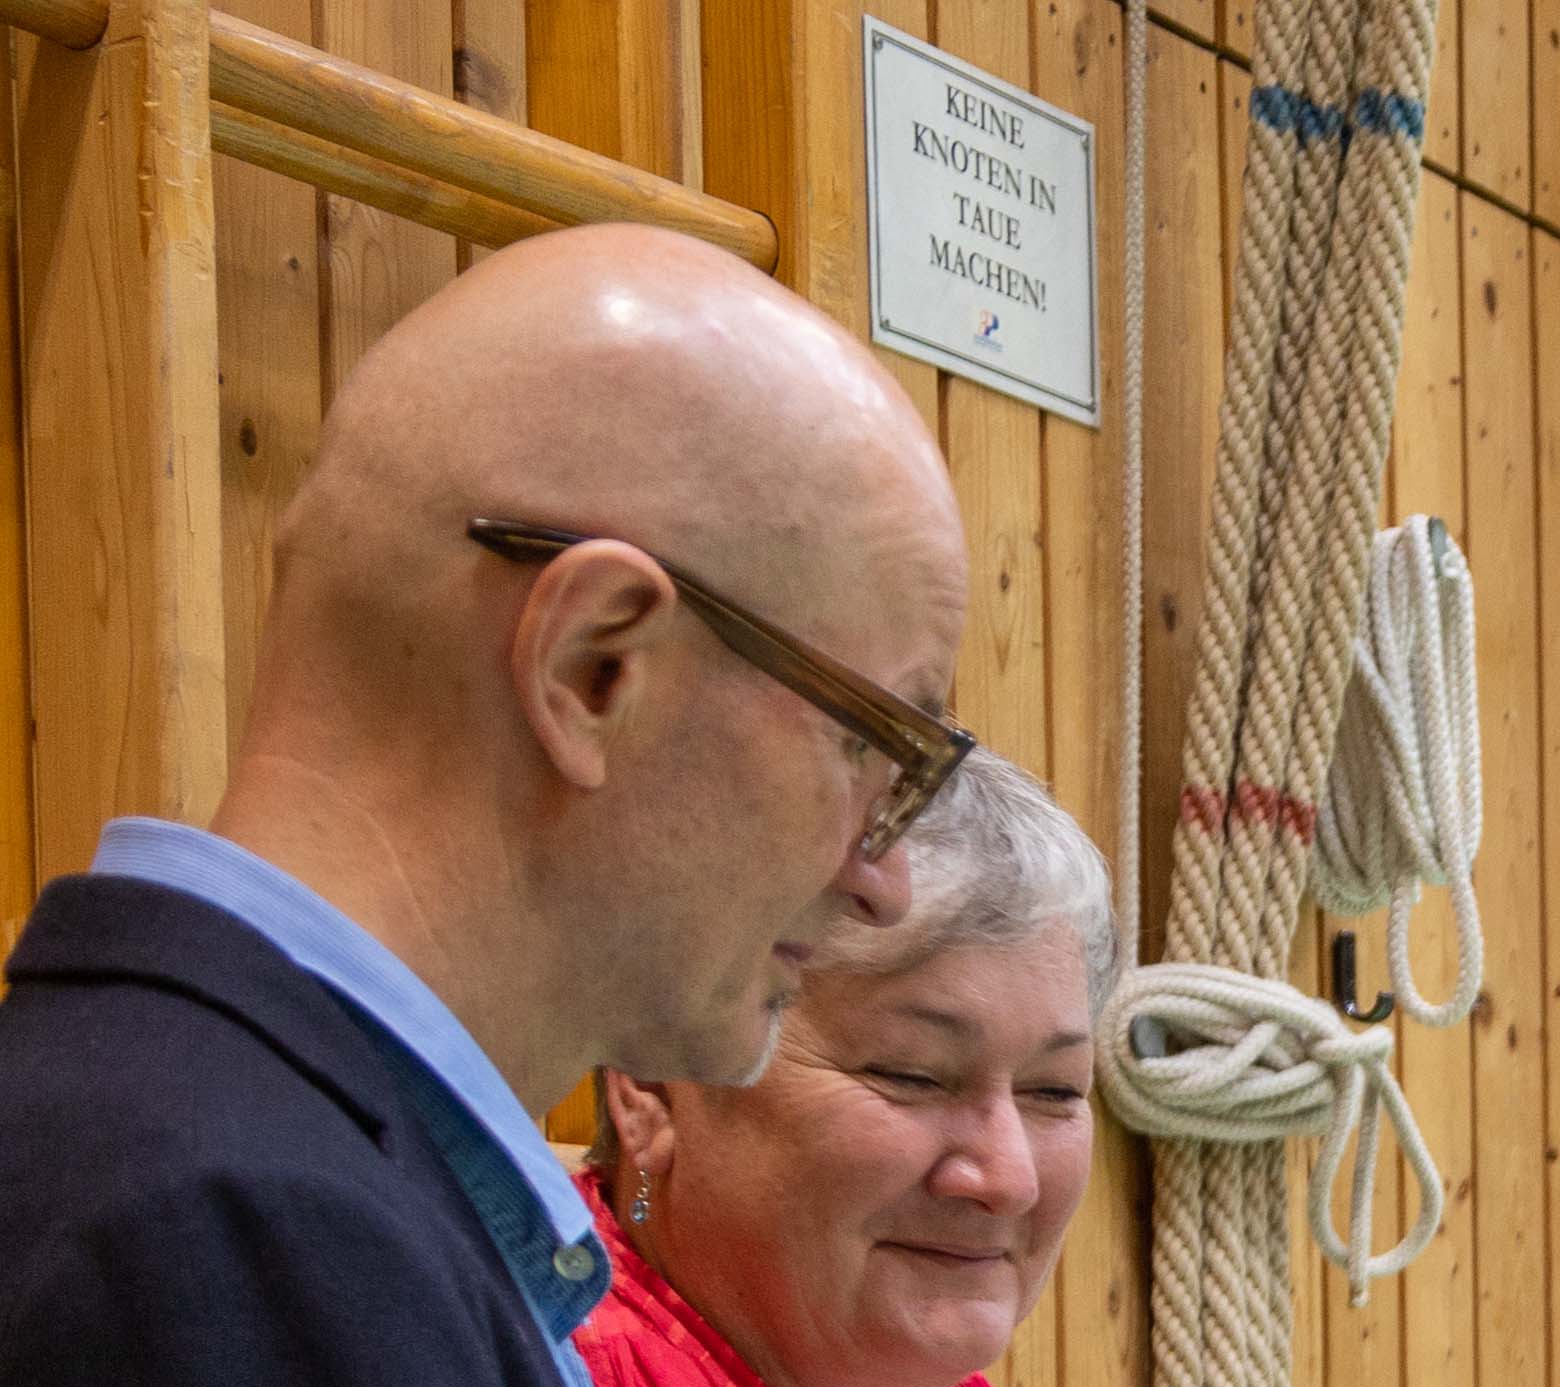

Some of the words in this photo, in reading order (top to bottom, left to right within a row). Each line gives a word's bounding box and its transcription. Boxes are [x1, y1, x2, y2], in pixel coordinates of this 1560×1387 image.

[945, 84, 1025, 150] KEINE
[912, 121, 1022, 200] KNOTEN
[1029, 174, 1057, 215] IN
[953, 193, 1022, 251] TAUE
[929, 234, 1048, 313] MACHEN!
